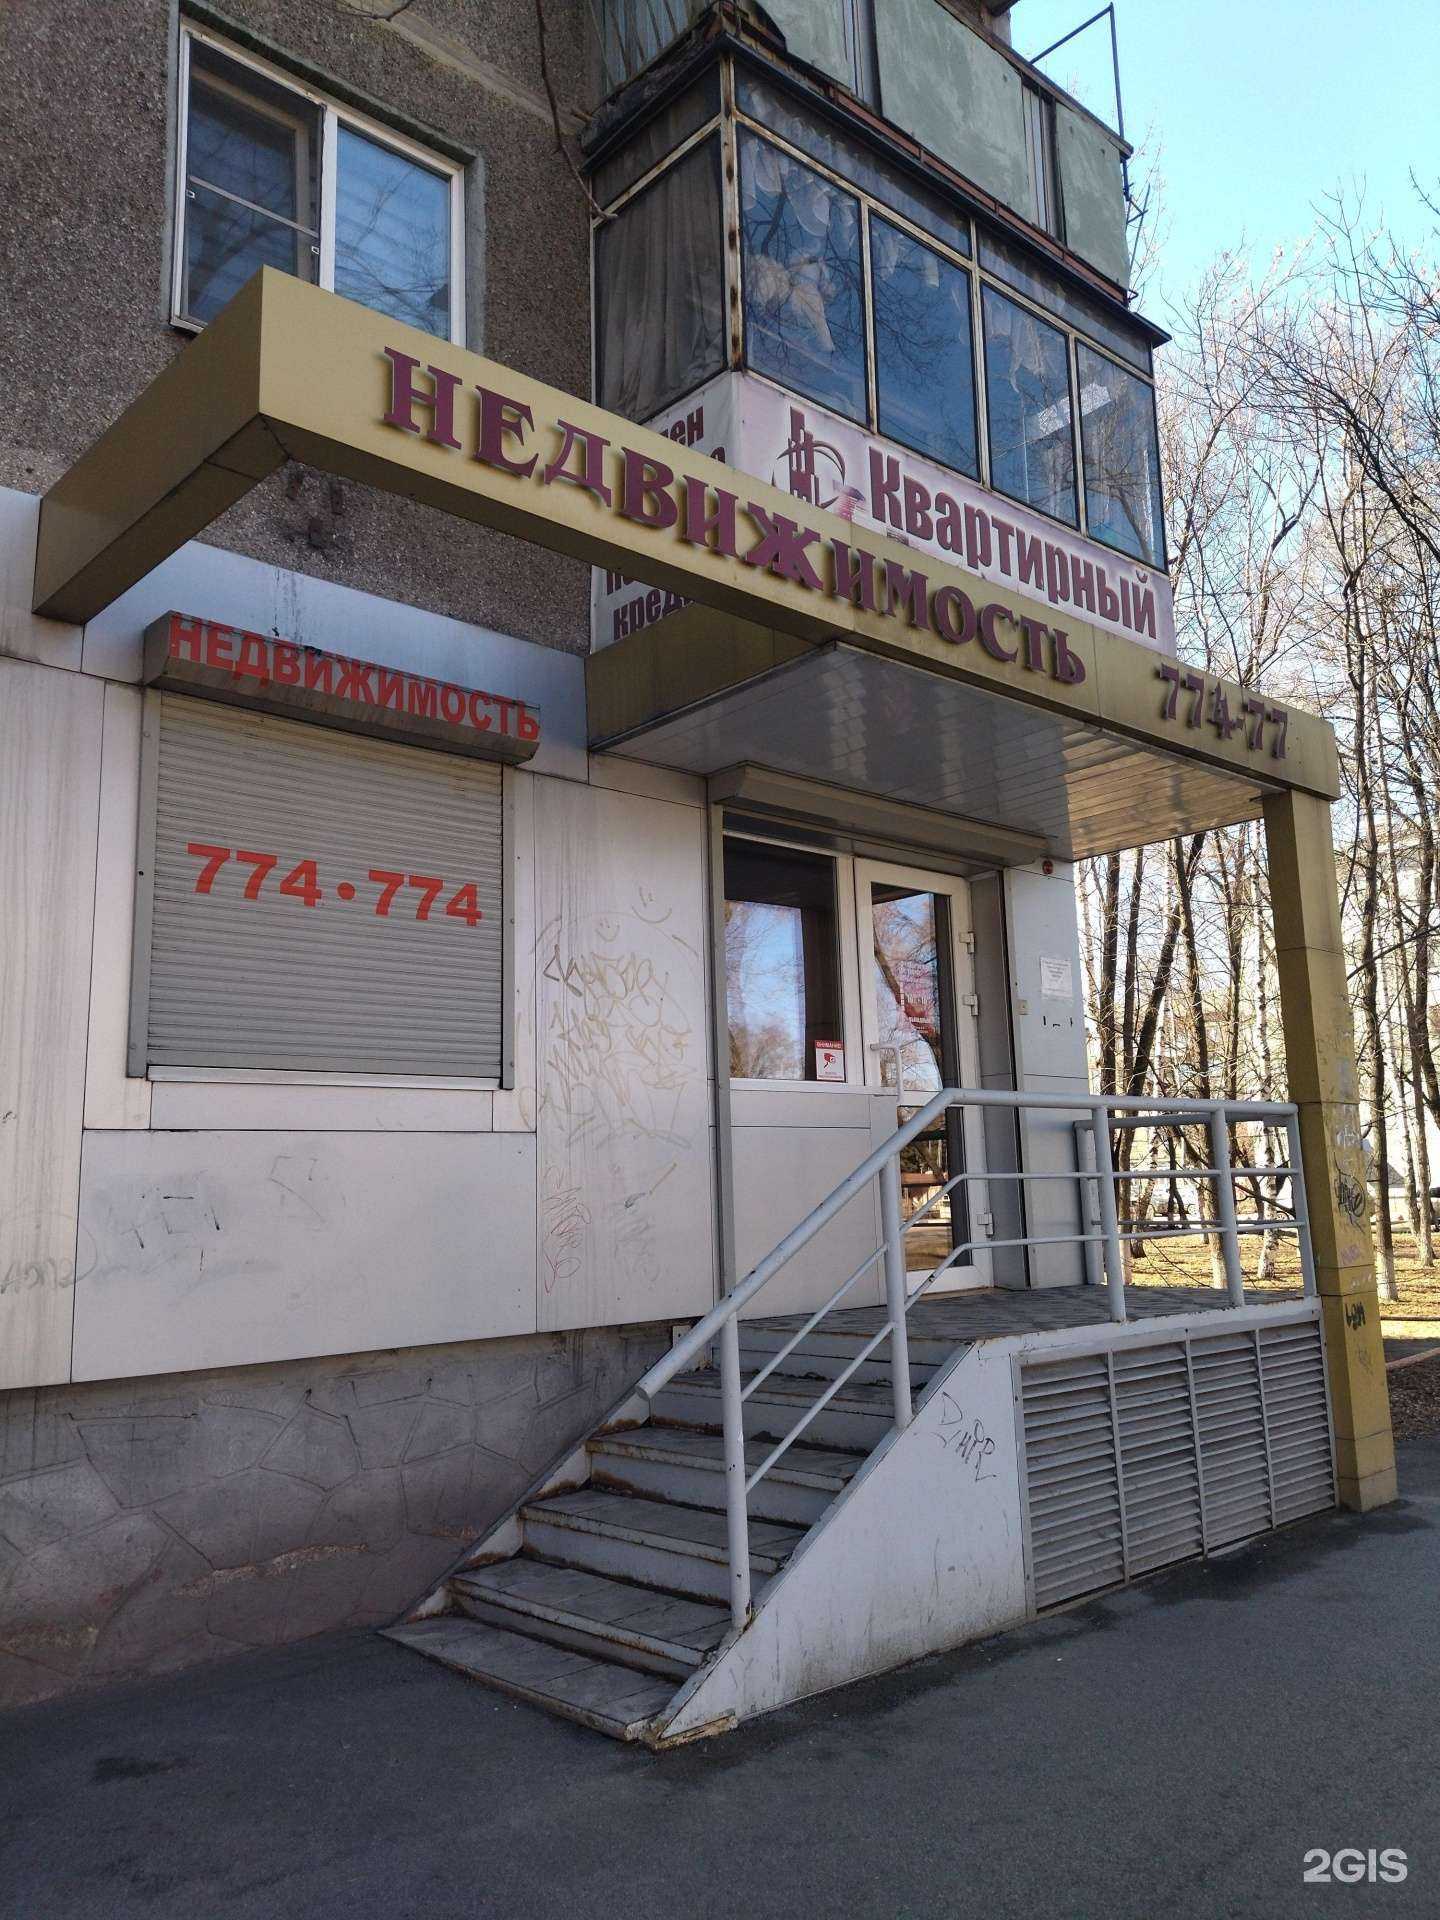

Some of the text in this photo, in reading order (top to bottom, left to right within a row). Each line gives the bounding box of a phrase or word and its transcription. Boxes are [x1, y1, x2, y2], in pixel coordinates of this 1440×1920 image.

[659, 406, 704, 447] ен
[384, 346, 1086, 684] НЕДВИЖИМОСТЬ
[868, 446, 1157, 640] Квартирный
[170, 612, 540, 740] НЕДВИЖИМОСТЬ
